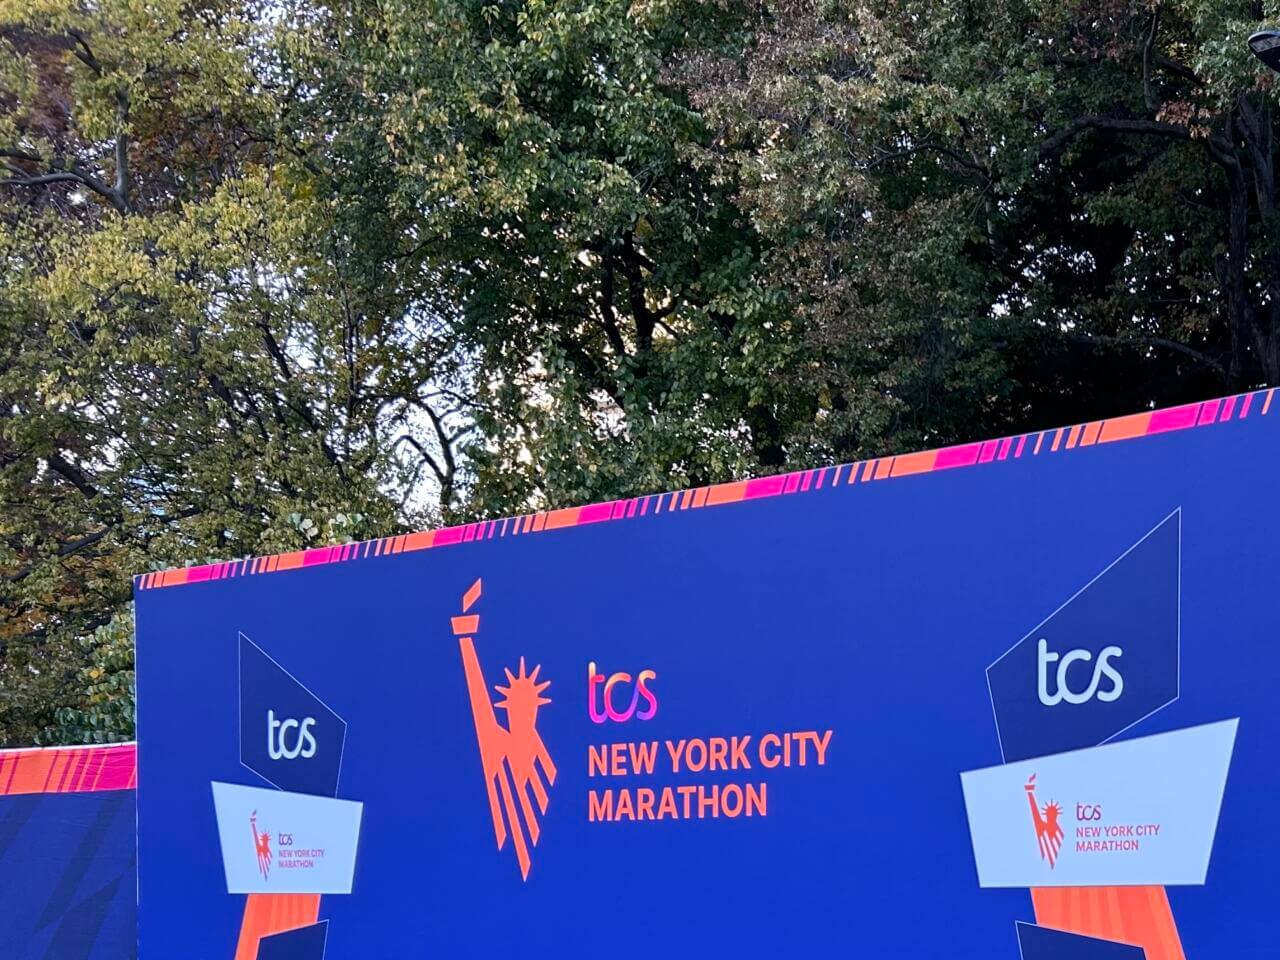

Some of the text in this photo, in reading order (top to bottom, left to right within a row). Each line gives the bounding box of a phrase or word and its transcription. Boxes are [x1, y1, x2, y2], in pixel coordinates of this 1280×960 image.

[1038, 639, 1123, 705] tcs
[589, 662, 657, 723] tcs
[268, 710, 316, 759] tcs
[589, 730, 832, 776] NEW YORK CITY
[589, 783, 766, 821] MARATHON
[1077, 803, 1101, 821] tcs
[1077, 825, 1159, 837] NEW YORK CITY
[1077, 840, 1138, 851] MARATHON
[278, 849, 292, 858] NEW
